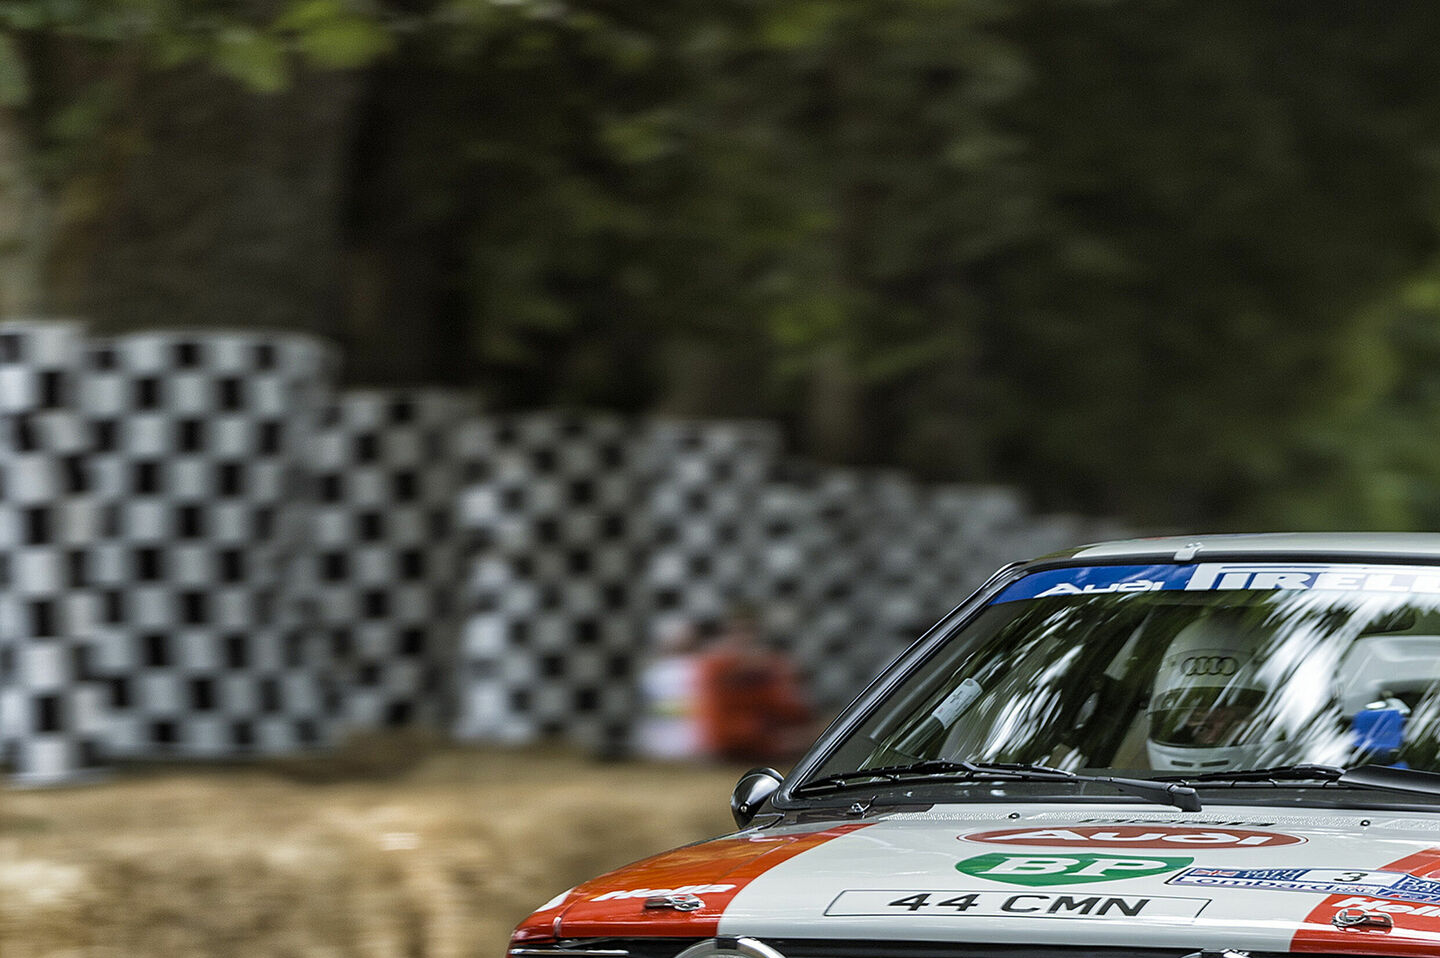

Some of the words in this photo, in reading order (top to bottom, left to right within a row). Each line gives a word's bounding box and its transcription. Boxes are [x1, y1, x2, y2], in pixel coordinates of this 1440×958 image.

[977, 857, 1168, 877] BP
[1333, 872, 1368, 882] 3
[888, 893, 981, 911] 44
[1000, 895, 1150, 916] CMN
